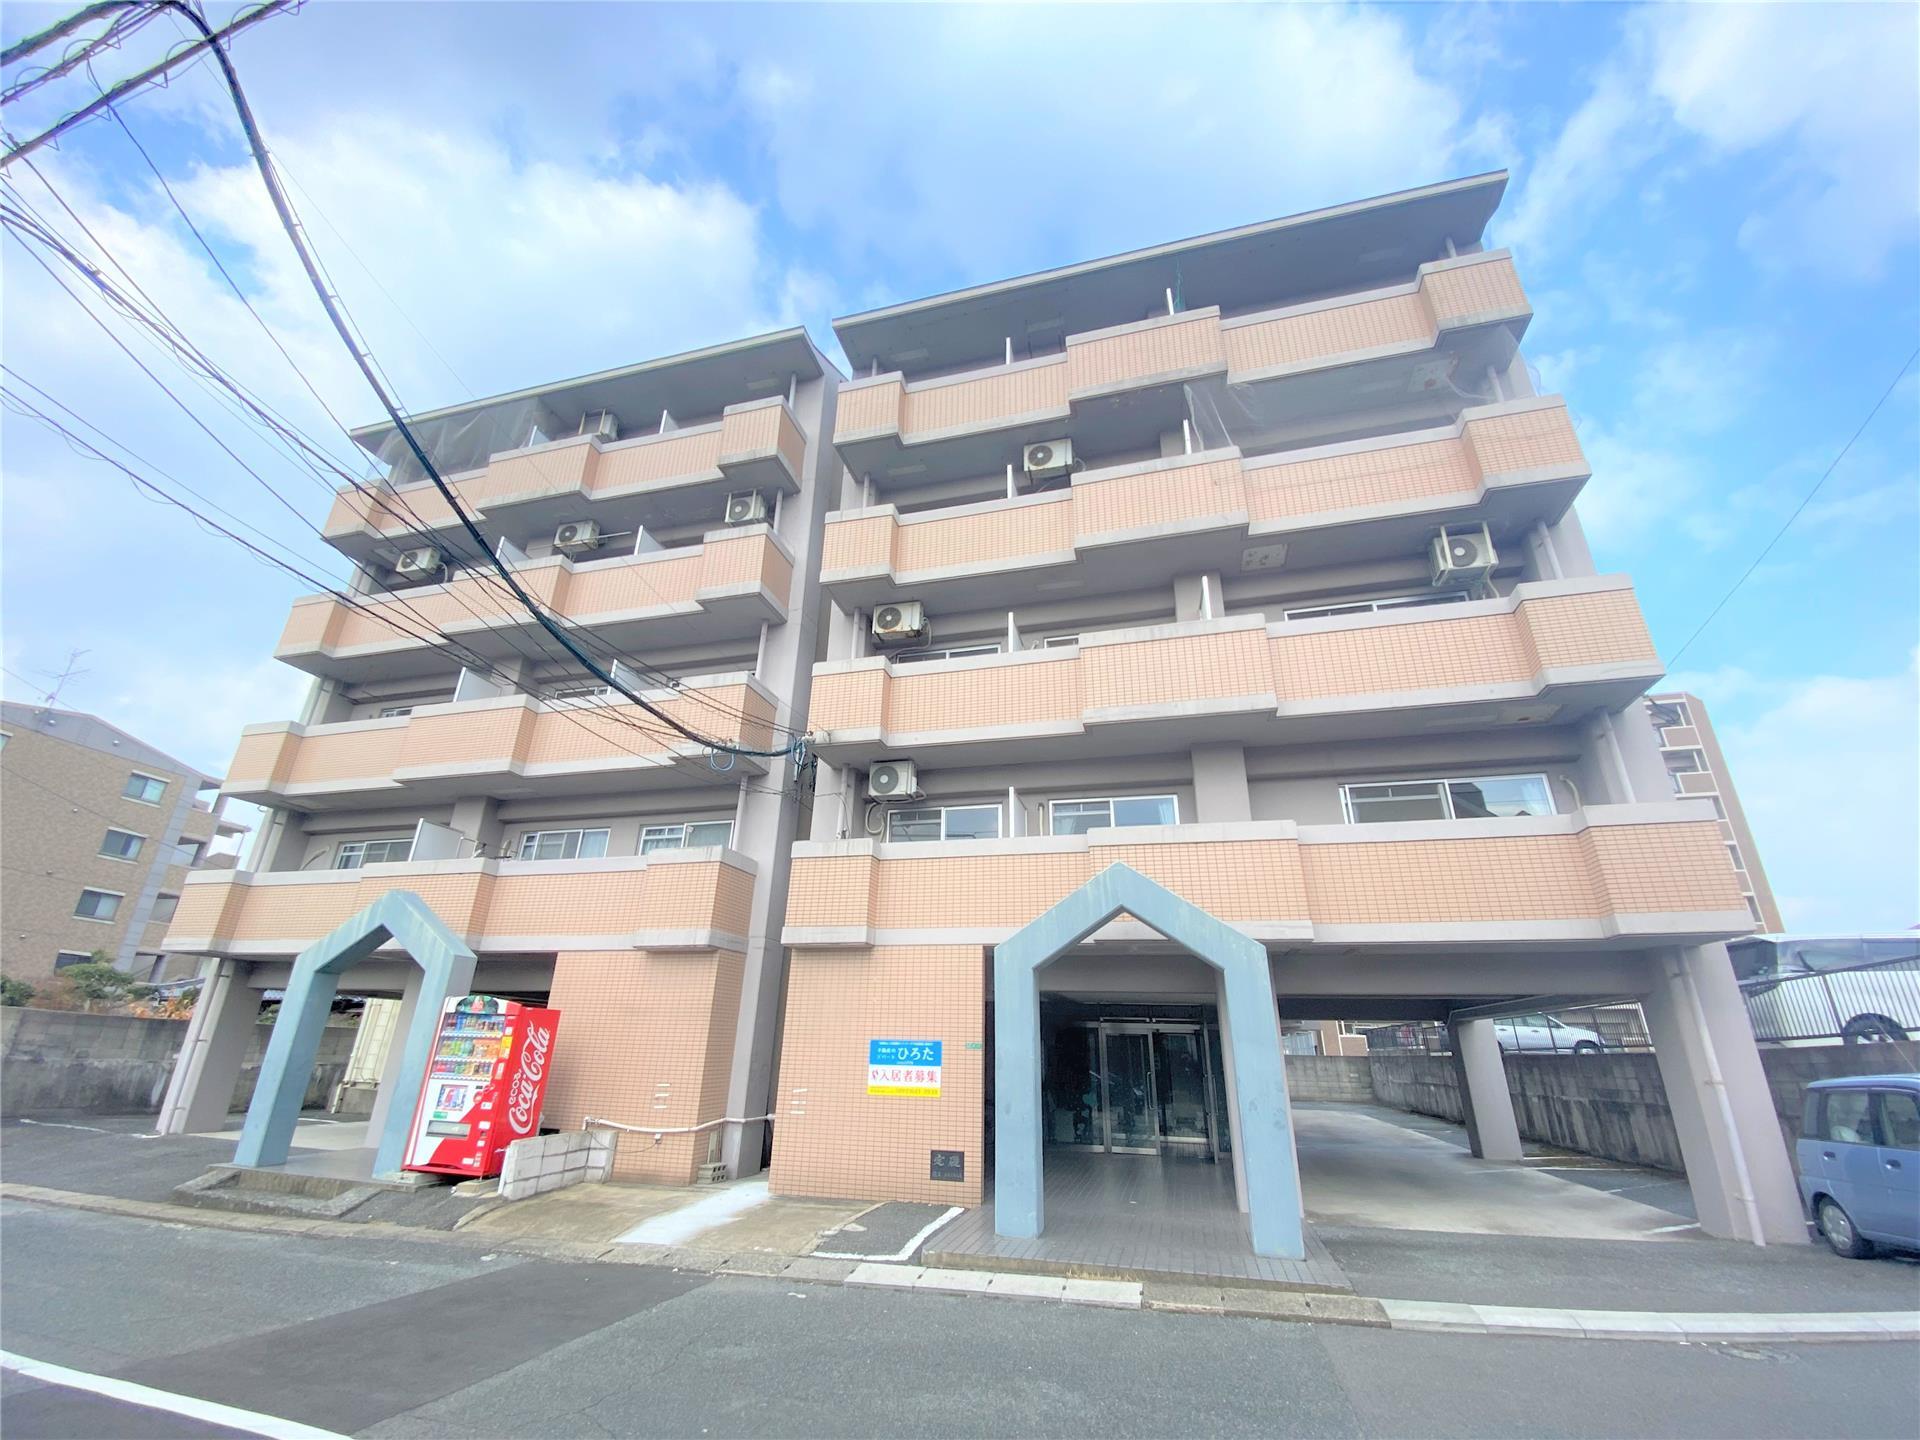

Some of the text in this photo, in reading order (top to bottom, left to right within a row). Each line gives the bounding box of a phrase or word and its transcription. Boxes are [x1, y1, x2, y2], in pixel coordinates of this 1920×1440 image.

[897, 1046, 934, 1061] ひろた
[508, 1019, 551, 1135] Coca-Cola
[880, 1069, 938, 1083] 入居者募集
